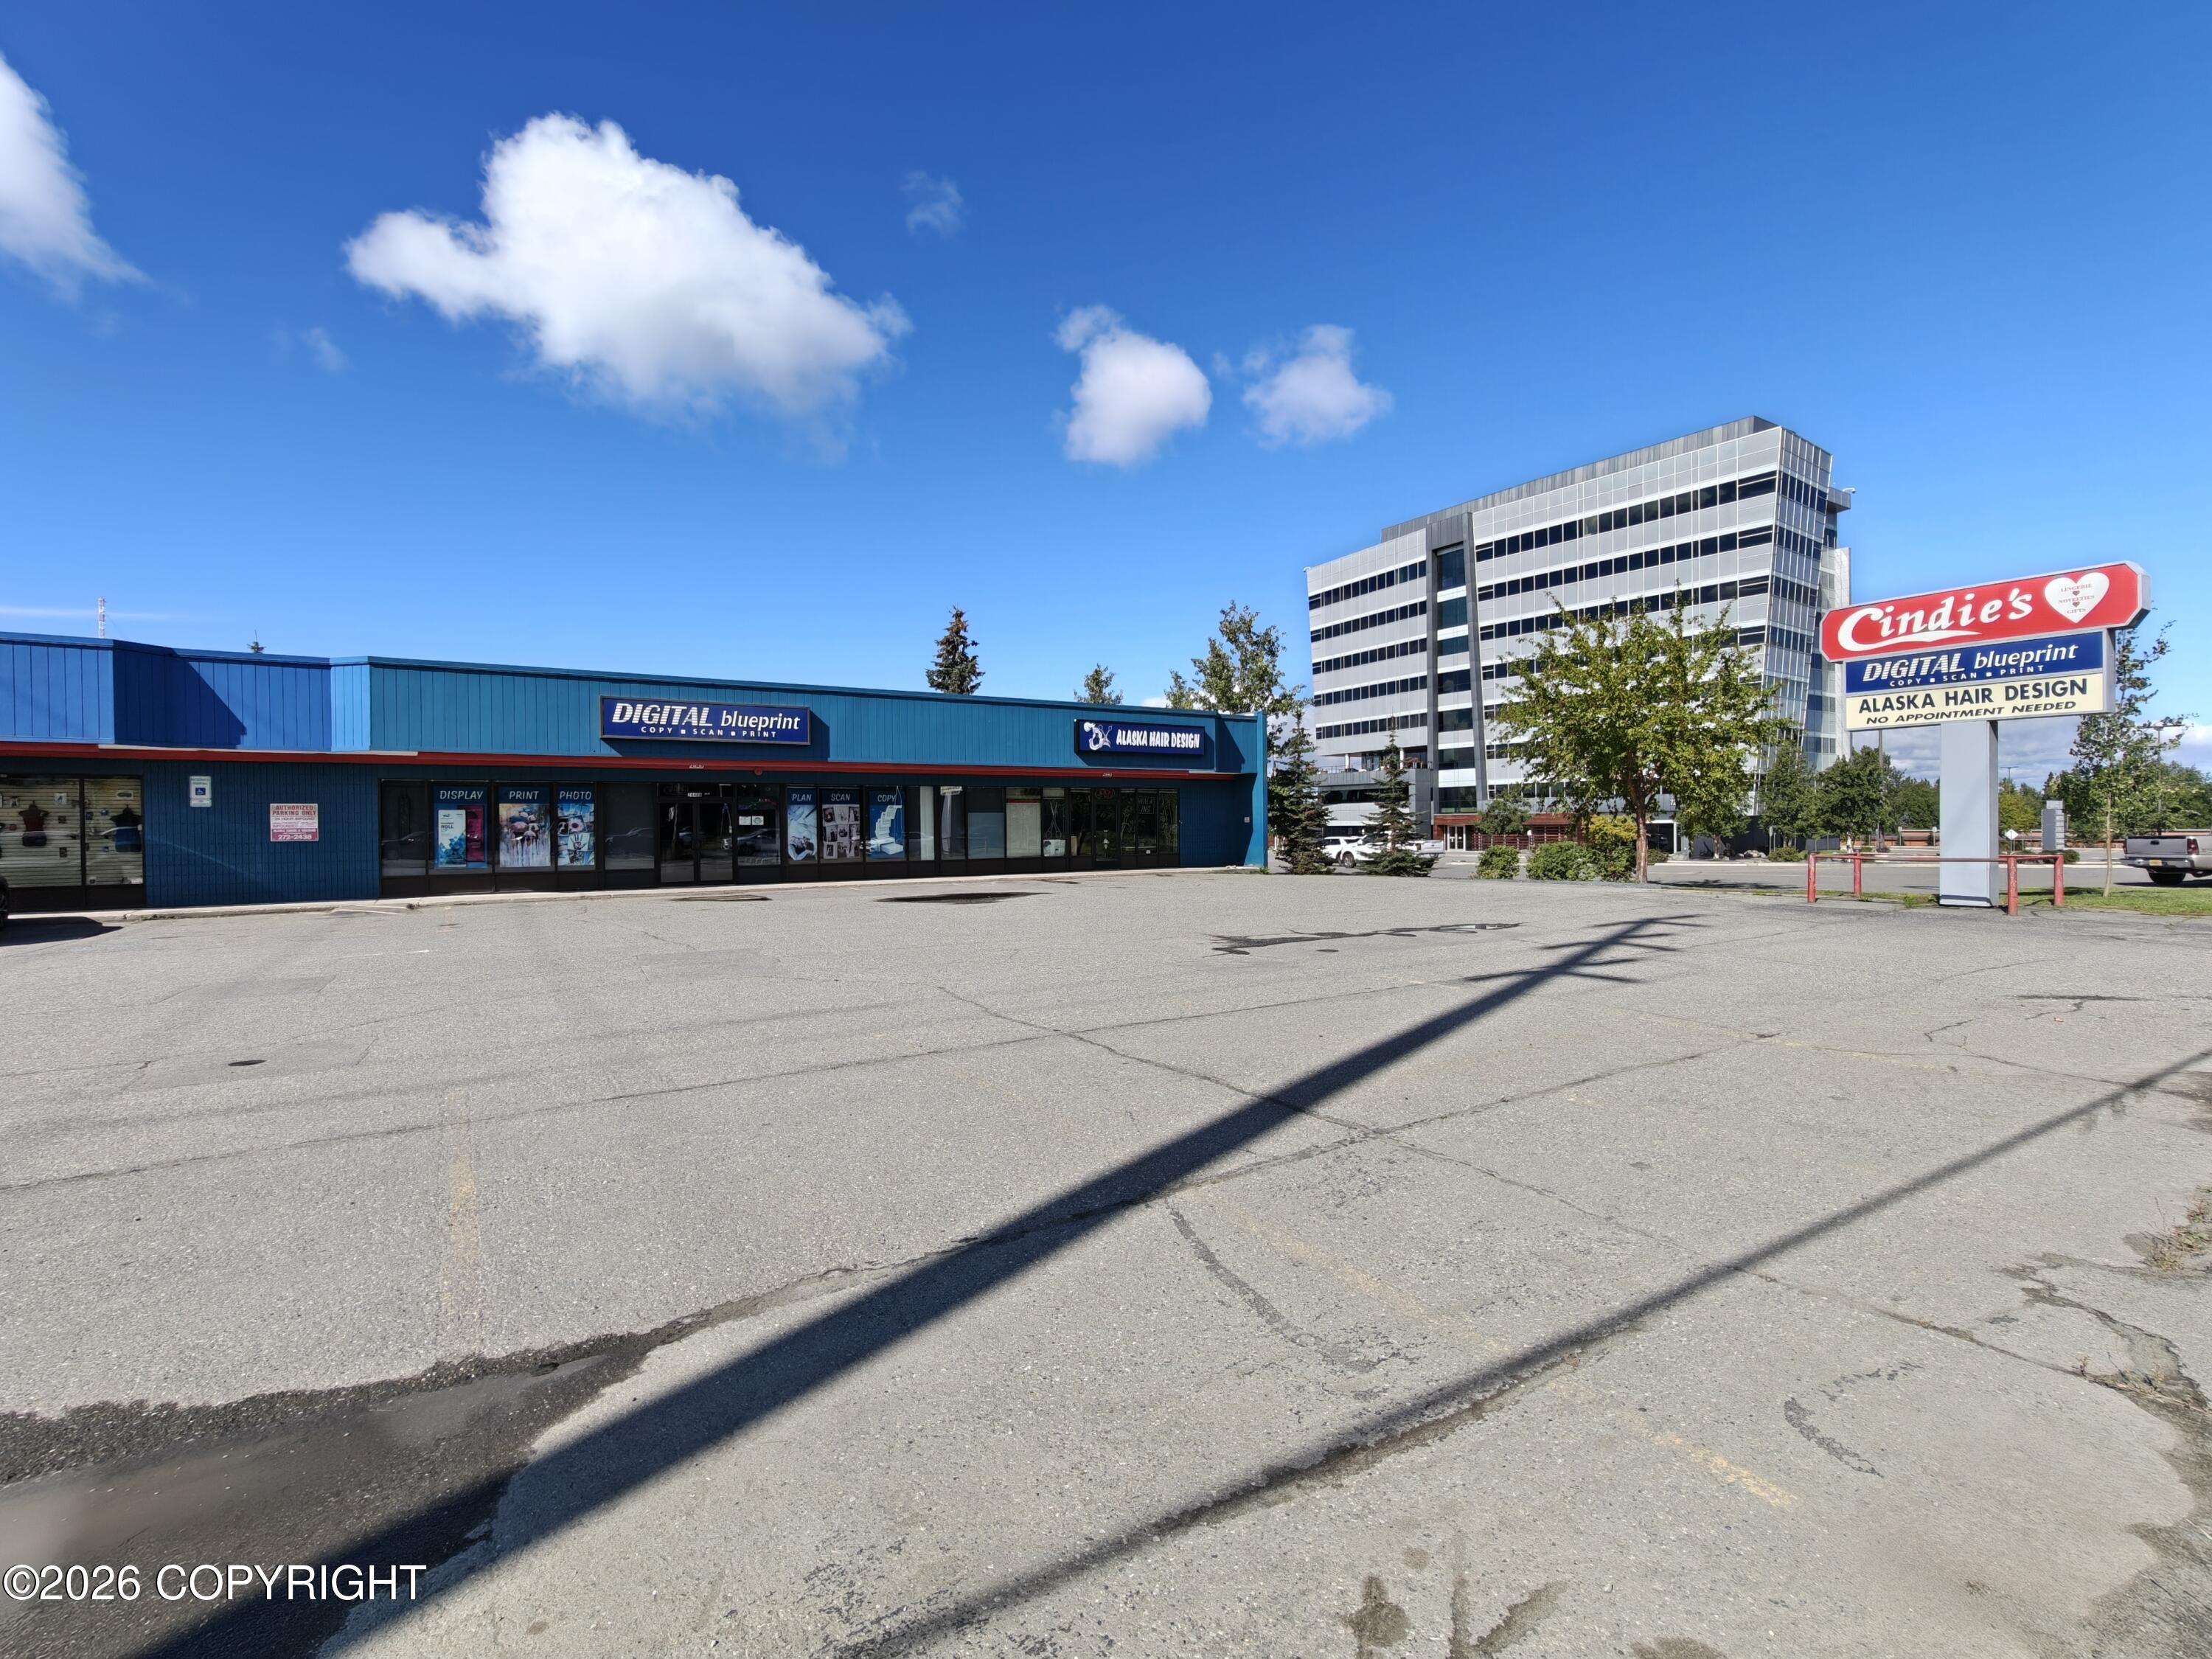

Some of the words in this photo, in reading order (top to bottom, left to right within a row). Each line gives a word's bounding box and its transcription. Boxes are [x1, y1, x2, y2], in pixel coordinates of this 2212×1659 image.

[2060, 583, 2092, 592] LINGERIE
[2058, 595, 2095, 604] NOVELTIES
[1837, 588, 2033, 652] Cindie's
[1863, 653, 1966, 682] DIGITAL
[1974, 643, 2079, 669] blueprint
[1889, 678, 1921, 687] COPY
[1943, 672, 1978, 682] SCAN
[2000, 665, 2045, 675] PRINT
[1858, 693, 1935, 714] ALASKA
[1945, 687, 1994, 707] HAIR
[2005, 678, 2087, 702] DESIGN
[612, 703, 713, 726] DIGITAL
[720, 710, 801, 730] blueprint
[1865, 716, 1888, 724] NO
[1895, 707, 2005, 723] APPOINTMENT
[2011, 700, 2077, 713] NEEDED
[1116, 729, 1148, 747] ALASKA
[1149, 731, 1169, 748] HAIR
[1171, 732, 1200, 748] DESIGN
[439, 790, 484, 800] DISPLAY
[509, 790, 540, 800] PRINT
[559, 790, 592, 800] PHOTO
[791, 793, 812, 801] PLAN
[877, 794, 896, 802] COPY
